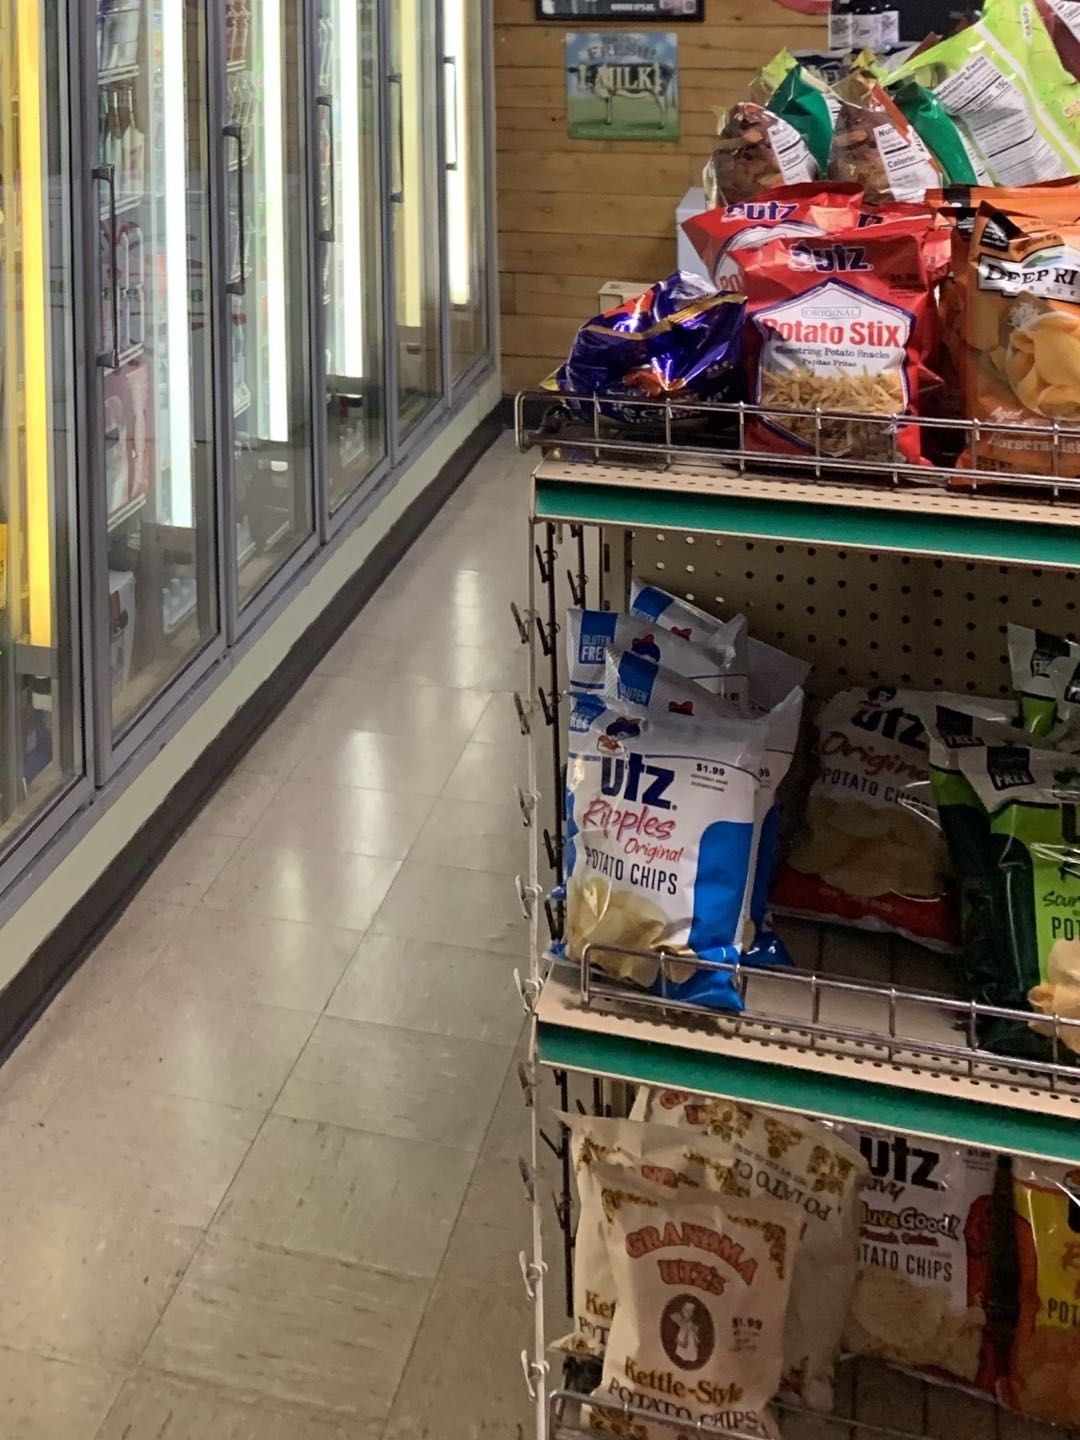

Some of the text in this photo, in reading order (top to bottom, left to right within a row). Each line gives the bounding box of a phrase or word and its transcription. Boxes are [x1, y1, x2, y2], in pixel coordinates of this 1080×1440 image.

[984, 262, 1049, 282] DEEP
[804, 307, 859, 319] ORIGINAL
[761, 317, 902, 348] Potato Stix
[824, 346, 856, 358] Potato
[857, 348, 890, 360] Snacks
[580, 645, 608, 661] FRE
[696, 763, 726, 777] $1.99
[822, 766, 878, 797] POTATO
[582, 797, 677, 841] Ripples
[623, 836, 685, 865] Original
[585, 845, 678, 896] POTATO CHIPS
[626, 1221, 759, 1287] GRANDMA
[857, 1243, 954, 1283] TATO CHIPS
[623, 1355, 745, 1409] Kettle-Style
